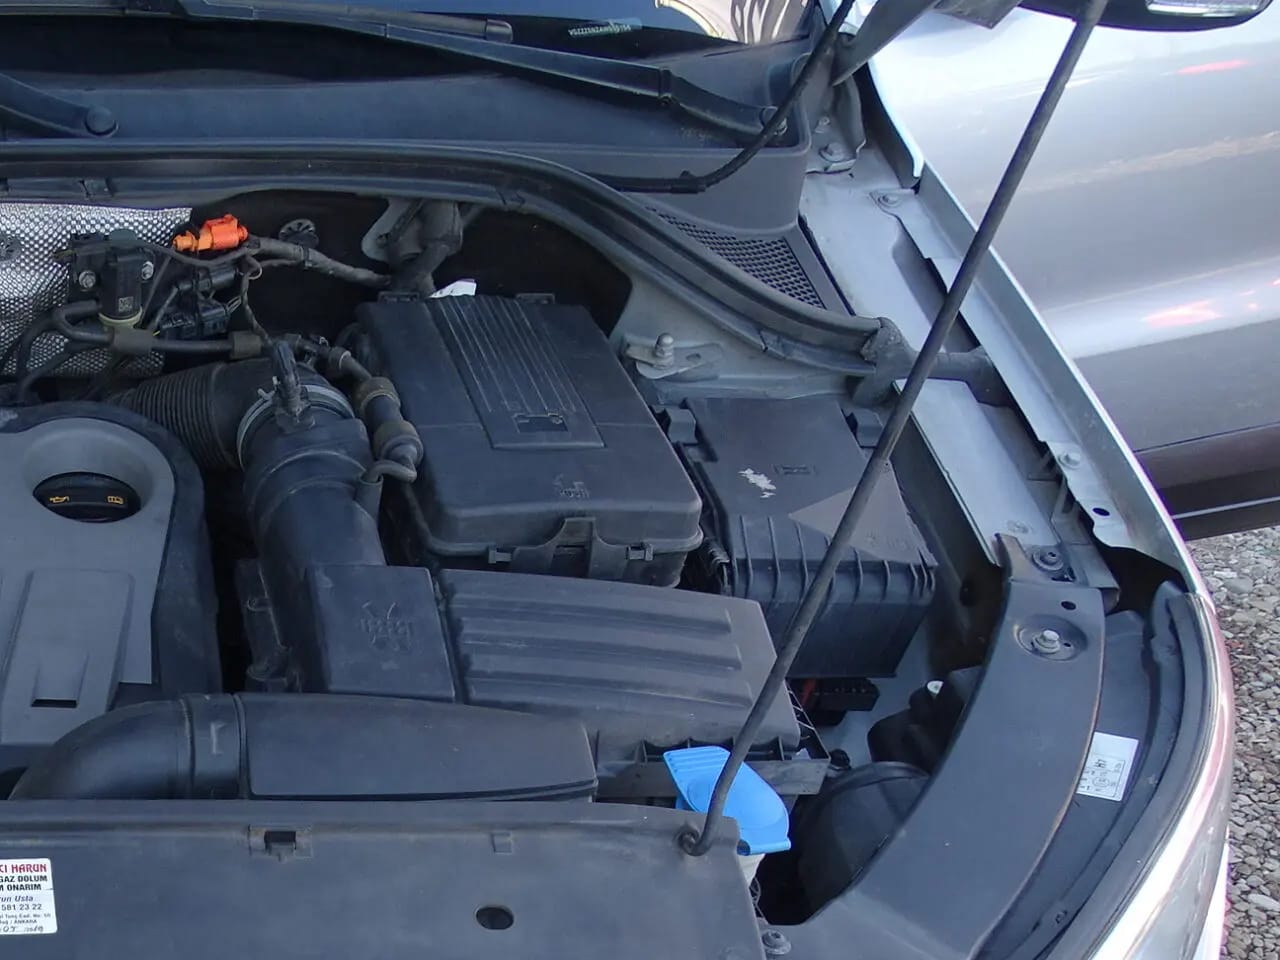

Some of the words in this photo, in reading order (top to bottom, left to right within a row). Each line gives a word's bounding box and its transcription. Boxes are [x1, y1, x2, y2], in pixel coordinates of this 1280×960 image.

[11, 863, 47, 874] HARUN
[17, 875, 48, 883] DOLUM
[7, 883, 42, 891] ONARIM
